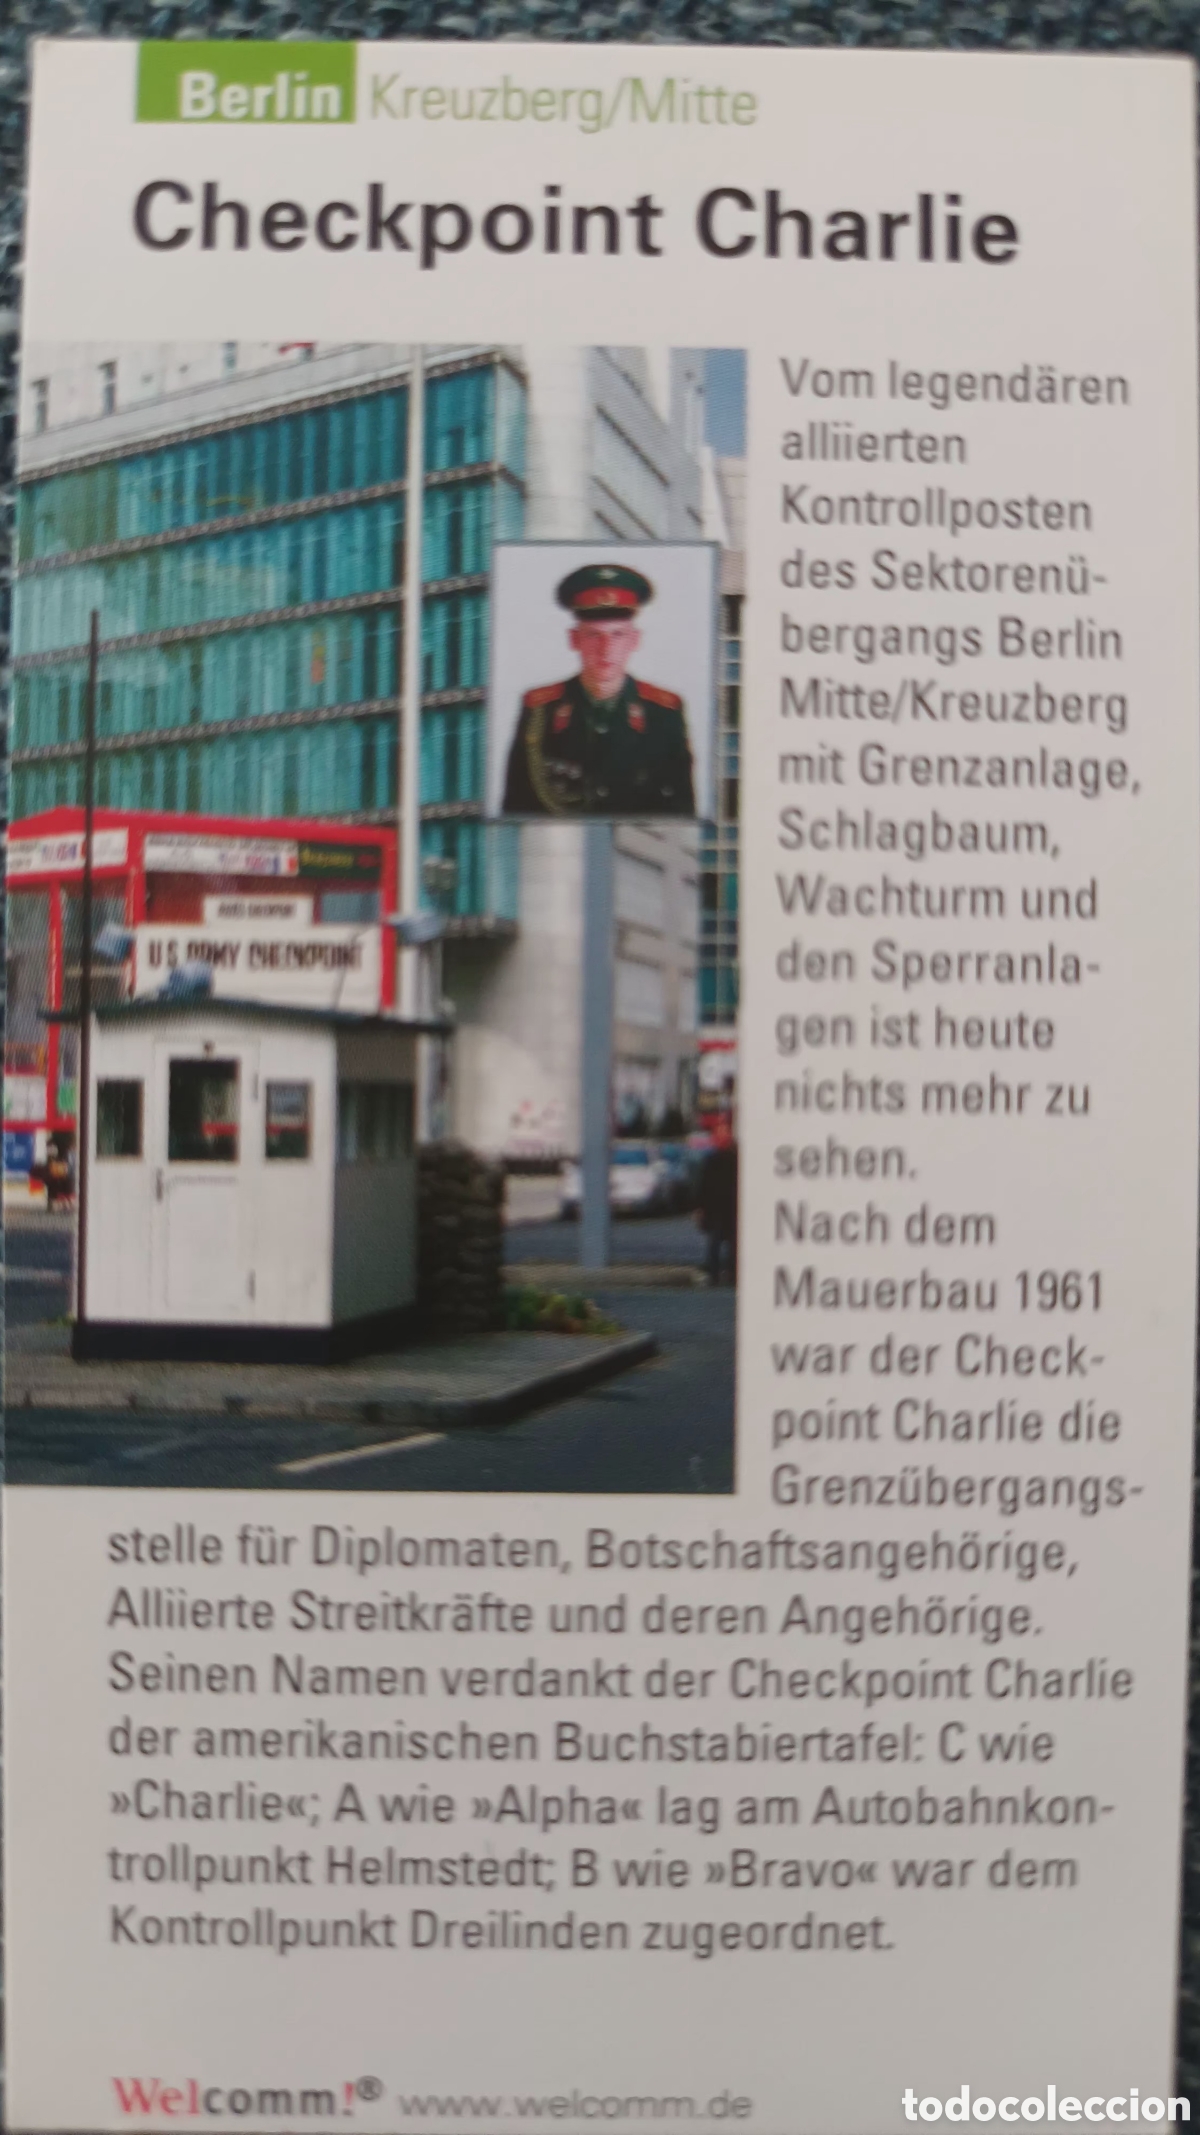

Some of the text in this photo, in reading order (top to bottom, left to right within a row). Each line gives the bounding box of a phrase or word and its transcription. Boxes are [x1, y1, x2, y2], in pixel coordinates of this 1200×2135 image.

[178, 71, 759, 134] Berlin Kreuzberg/Mitte
[132, 178, 1020, 271] Checkpoint Charlie
[780, 358, 1130, 410] Vom legendären
[781, 422, 967, 464] alliierten
[781, 485, 1092, 536] Kontrollposten
[780, 549, 1107, 595] des Sektorenü-
[781, 614, 1123, 666] bergangs Berlin
[780, 677, 1128, 734] Mitte/Kreuzberg
[778, 743, 1140, 799] mit Grenzanlage,
[778, 807, 1060, 861] Schlagbaum,
[777, 874, 1098, 919] Wachturm und
[777, 939, 1100, 990] den Sperranla-
[775, 1005, 1054, 1056] gen ist heute
[774, 1069, 1090, 1115] nichts mehr zu
[774, 1136, 916, 1179] sehen.
[775, 1201, 995, 1245] Nach dem
[774, 1267, 1102, 1312] Mauerbau 1961
[770, 1333, 1105, 1377] war der Check-
[772, 1398, 1121, 1448] point Charlie die
[772, 1464, 1143, 1516] Grenzübergangs-
[108, 1523, 1078, 1581] stelle für Diplomaten, Botschaftsangehörige,
[107, 1587, 1043, 1645] Alliierte Streitkräfte und deren Angehörige.
[108, 1650, 1133, 1707] Seinen Namen verdankt der Checkpoint Charlie
[108, 1716, 1055, 1764] der amerikanischen Buchstabiertafel: C wie
[110, 1778, 1116, 1835] »Charlie«; A wie »Alpha« lag am Autobahnkon-
[107, 1844, 1078, 1892] trollpunkt Helmstedt; B wie »Bravo« war dem
[110, 1905, 894, 1960] Kontrollpunkt Dreilinden zugeordnet.
[399, 2088, 753, 2120] www.welcomm.de
